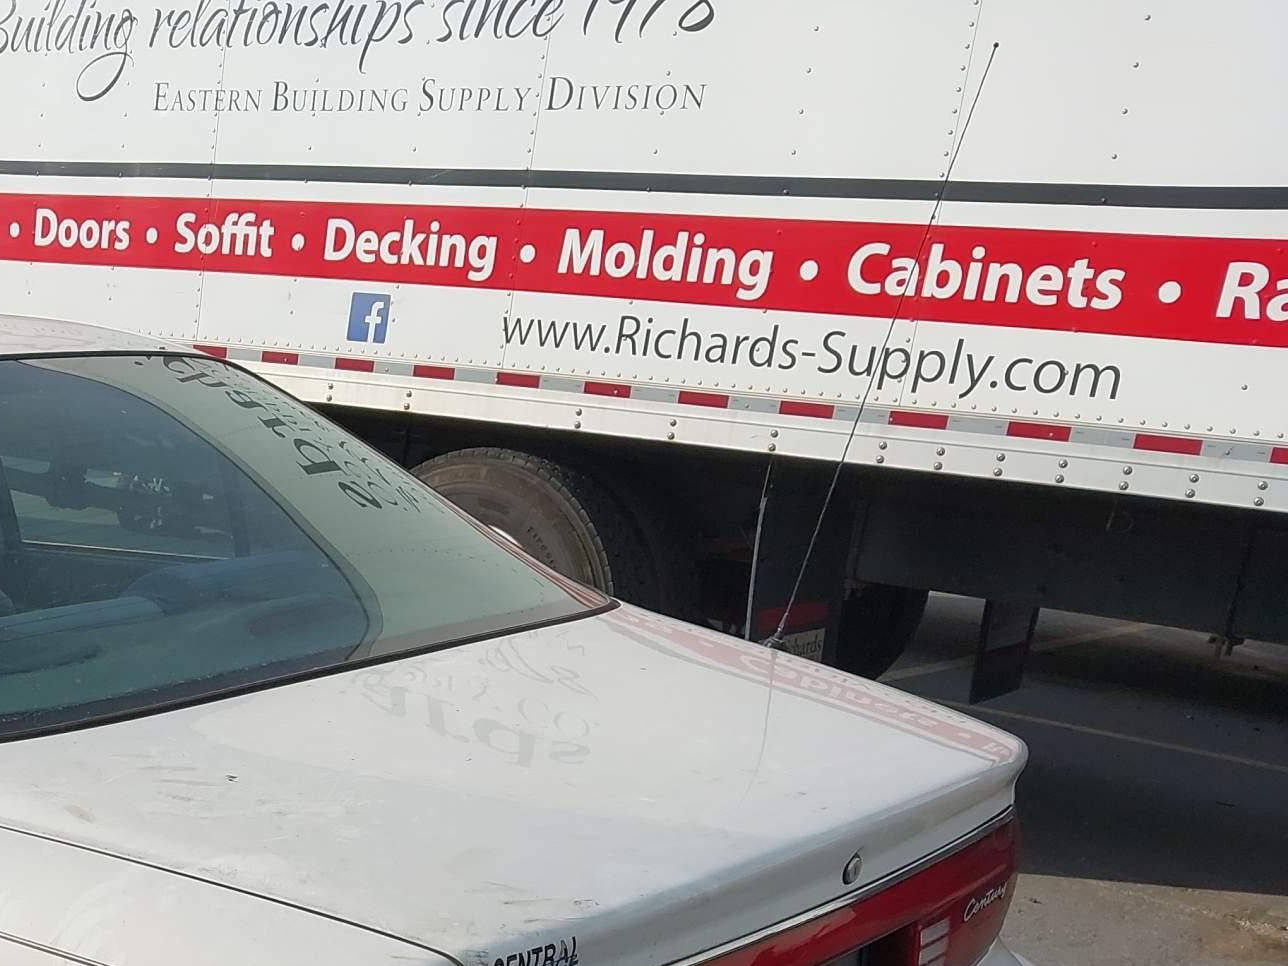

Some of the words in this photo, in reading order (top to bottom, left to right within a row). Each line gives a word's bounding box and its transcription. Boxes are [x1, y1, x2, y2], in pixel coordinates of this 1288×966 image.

[149, 0, 424, 74] relationships
[436, 0, 564, 43] since
[34, 208, 131, 251] Doors
[174, 212, 274, 258] Soffit
[323, 215, 498, 281] Decking
[557, 228, 774, 301] Molding
[847, 241, 1127, 311] Cabinets
[503, 315, 1121, 400] www.Richards-Supply.com
[963, 880, 1009, 922] Century
